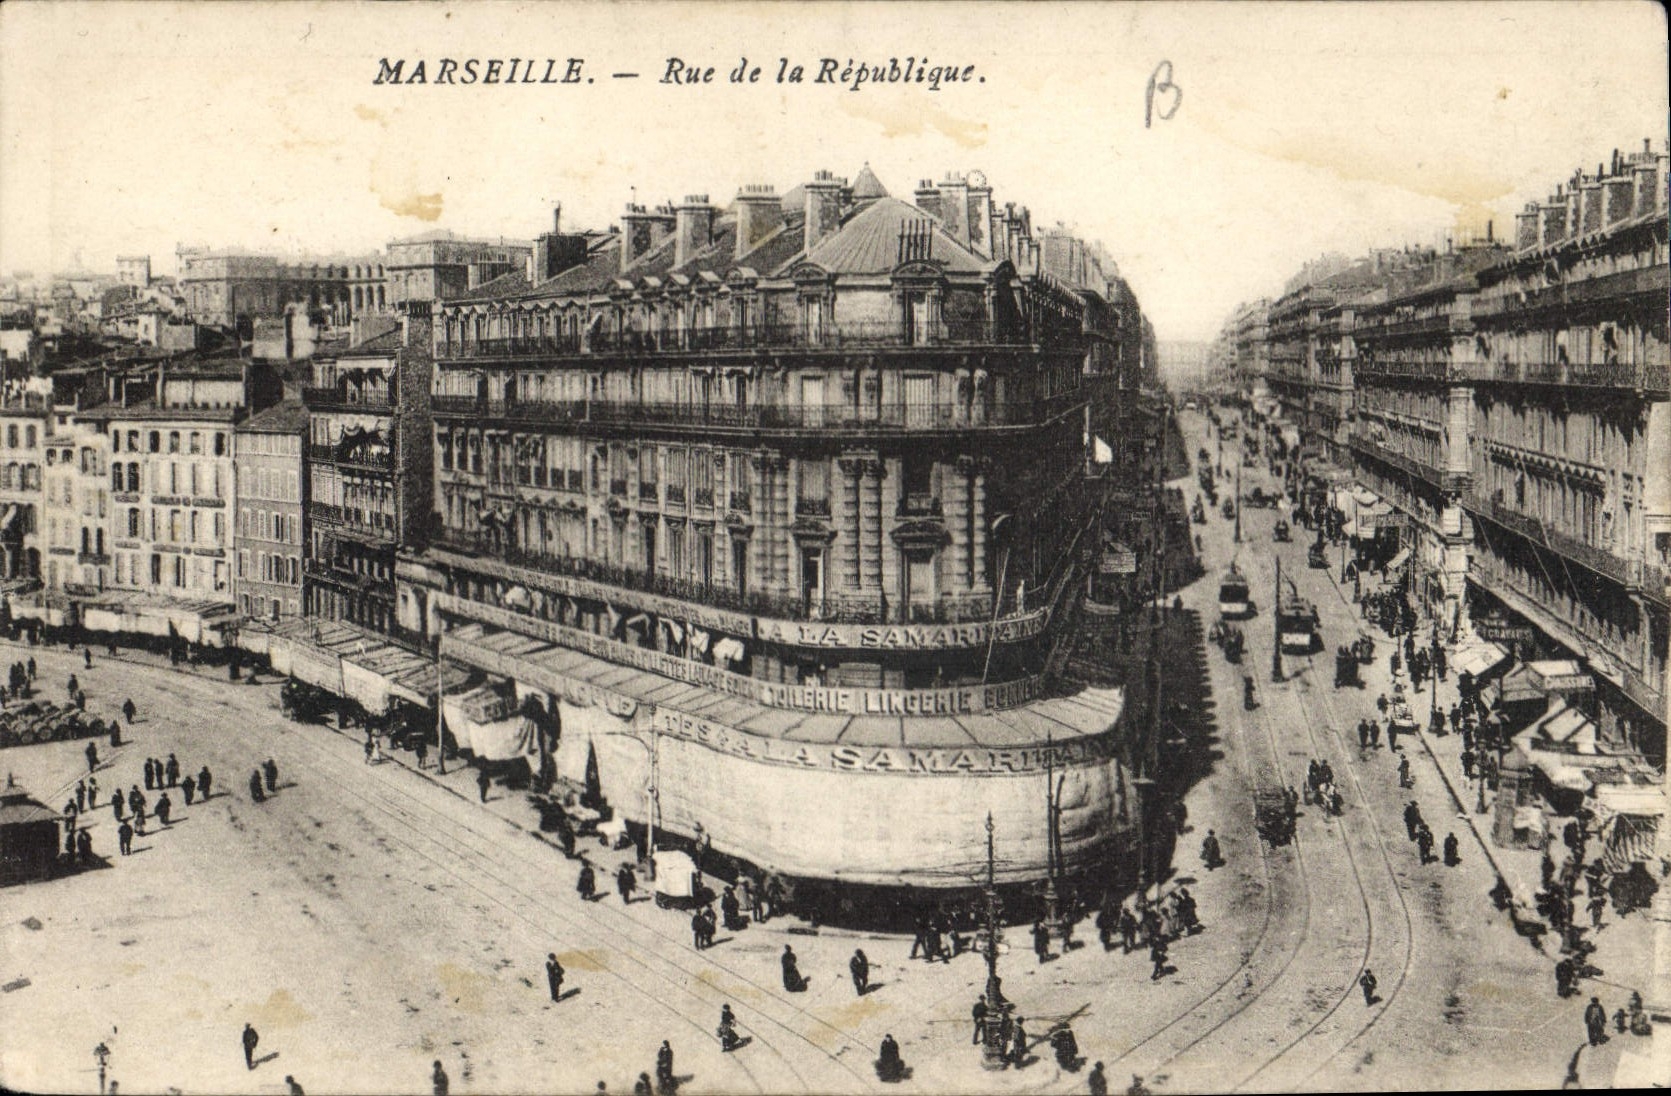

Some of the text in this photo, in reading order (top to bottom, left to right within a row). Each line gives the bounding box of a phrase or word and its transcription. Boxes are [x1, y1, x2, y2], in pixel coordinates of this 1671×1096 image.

[799, 624, 849, 648] LA
[860, 615, 1044, 649] SAMARITAINE
[864, 688, 972, 714] LINGERIE
